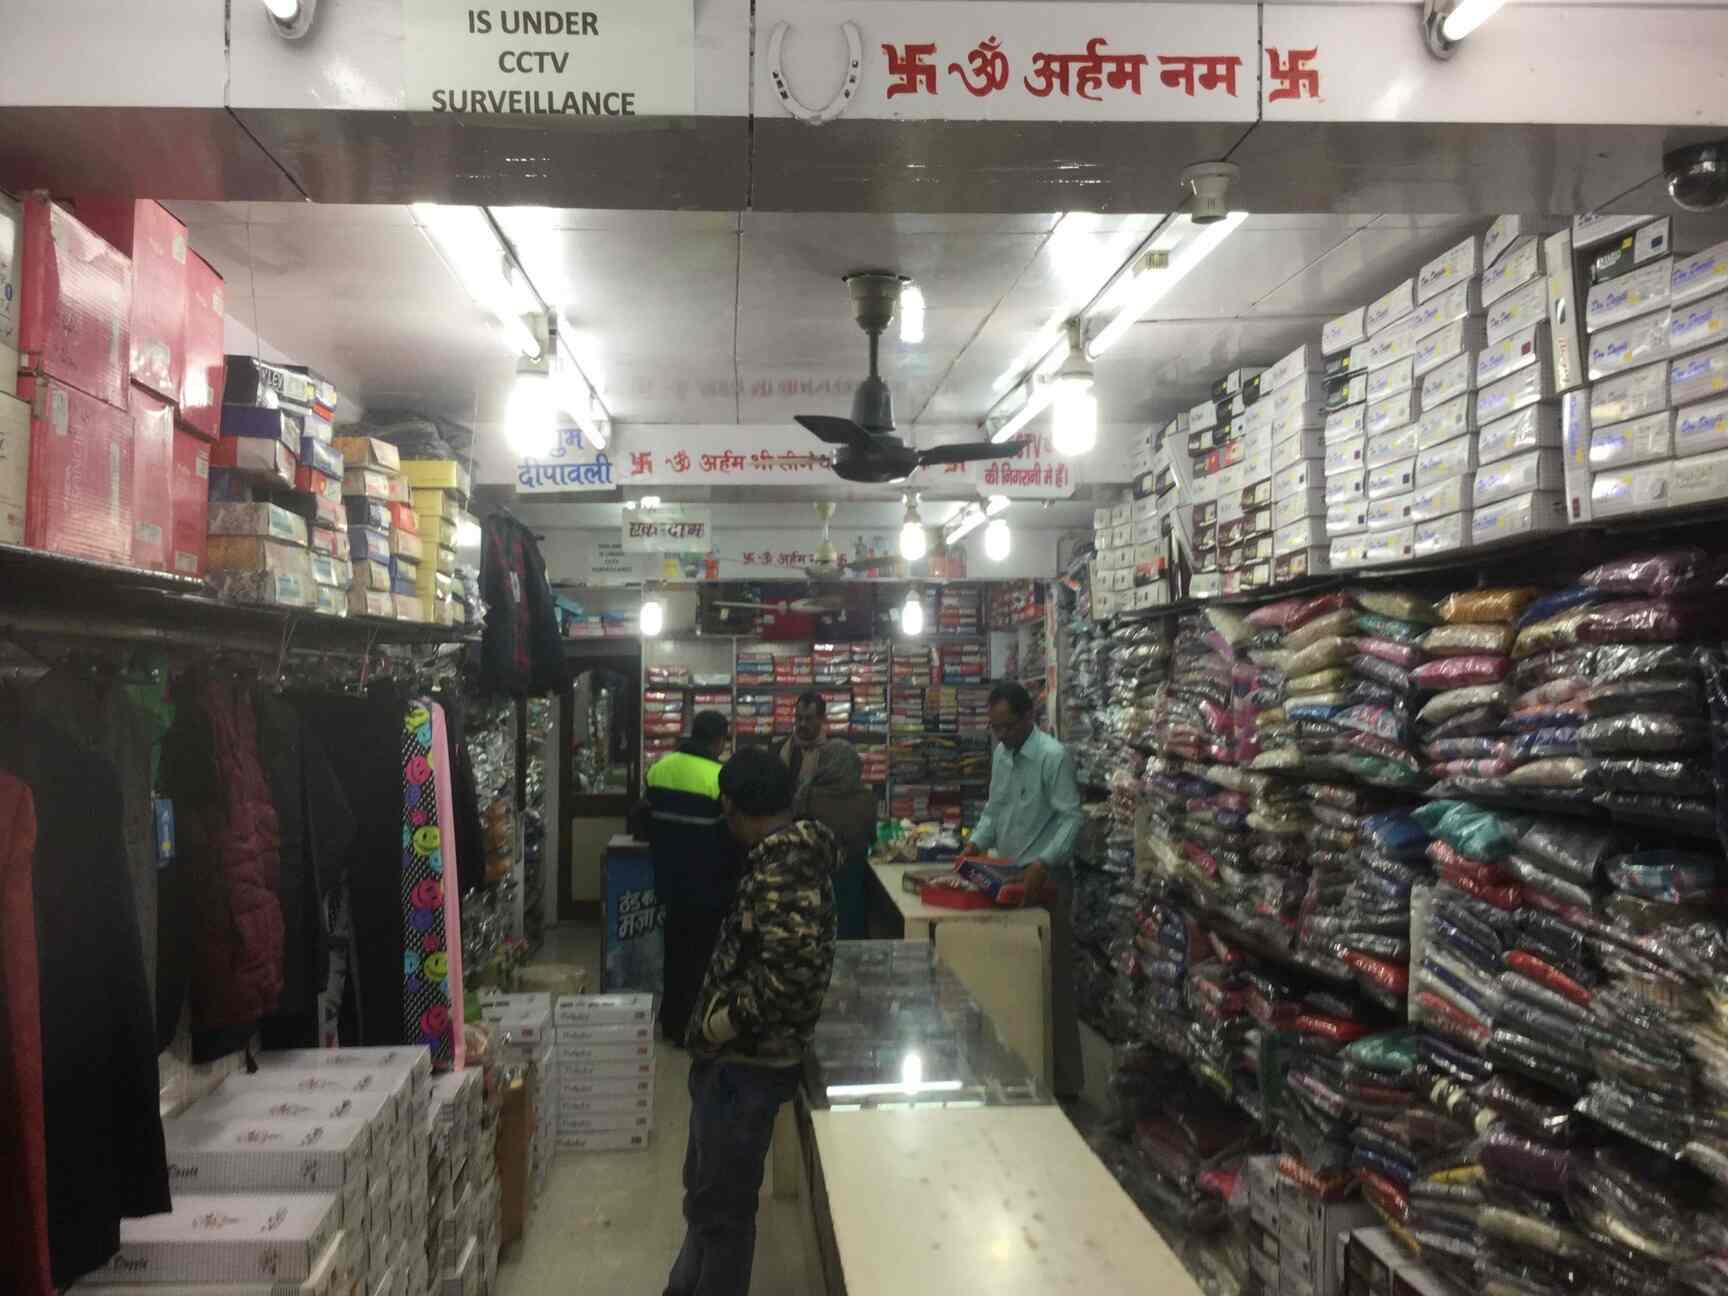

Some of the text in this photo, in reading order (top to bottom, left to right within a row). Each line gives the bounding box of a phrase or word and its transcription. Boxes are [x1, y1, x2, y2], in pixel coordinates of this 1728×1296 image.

[468, 9, 599, 36] IS UNDER
[498, 51, 569, 74] CCTV
[1024, 38, 1148, 101] अर्हम
[1157, 55, 1242, 97] नम
[432, 89, 636, 116] SURVEILLANCE
[518, 452, 614, 488] दीपावली
